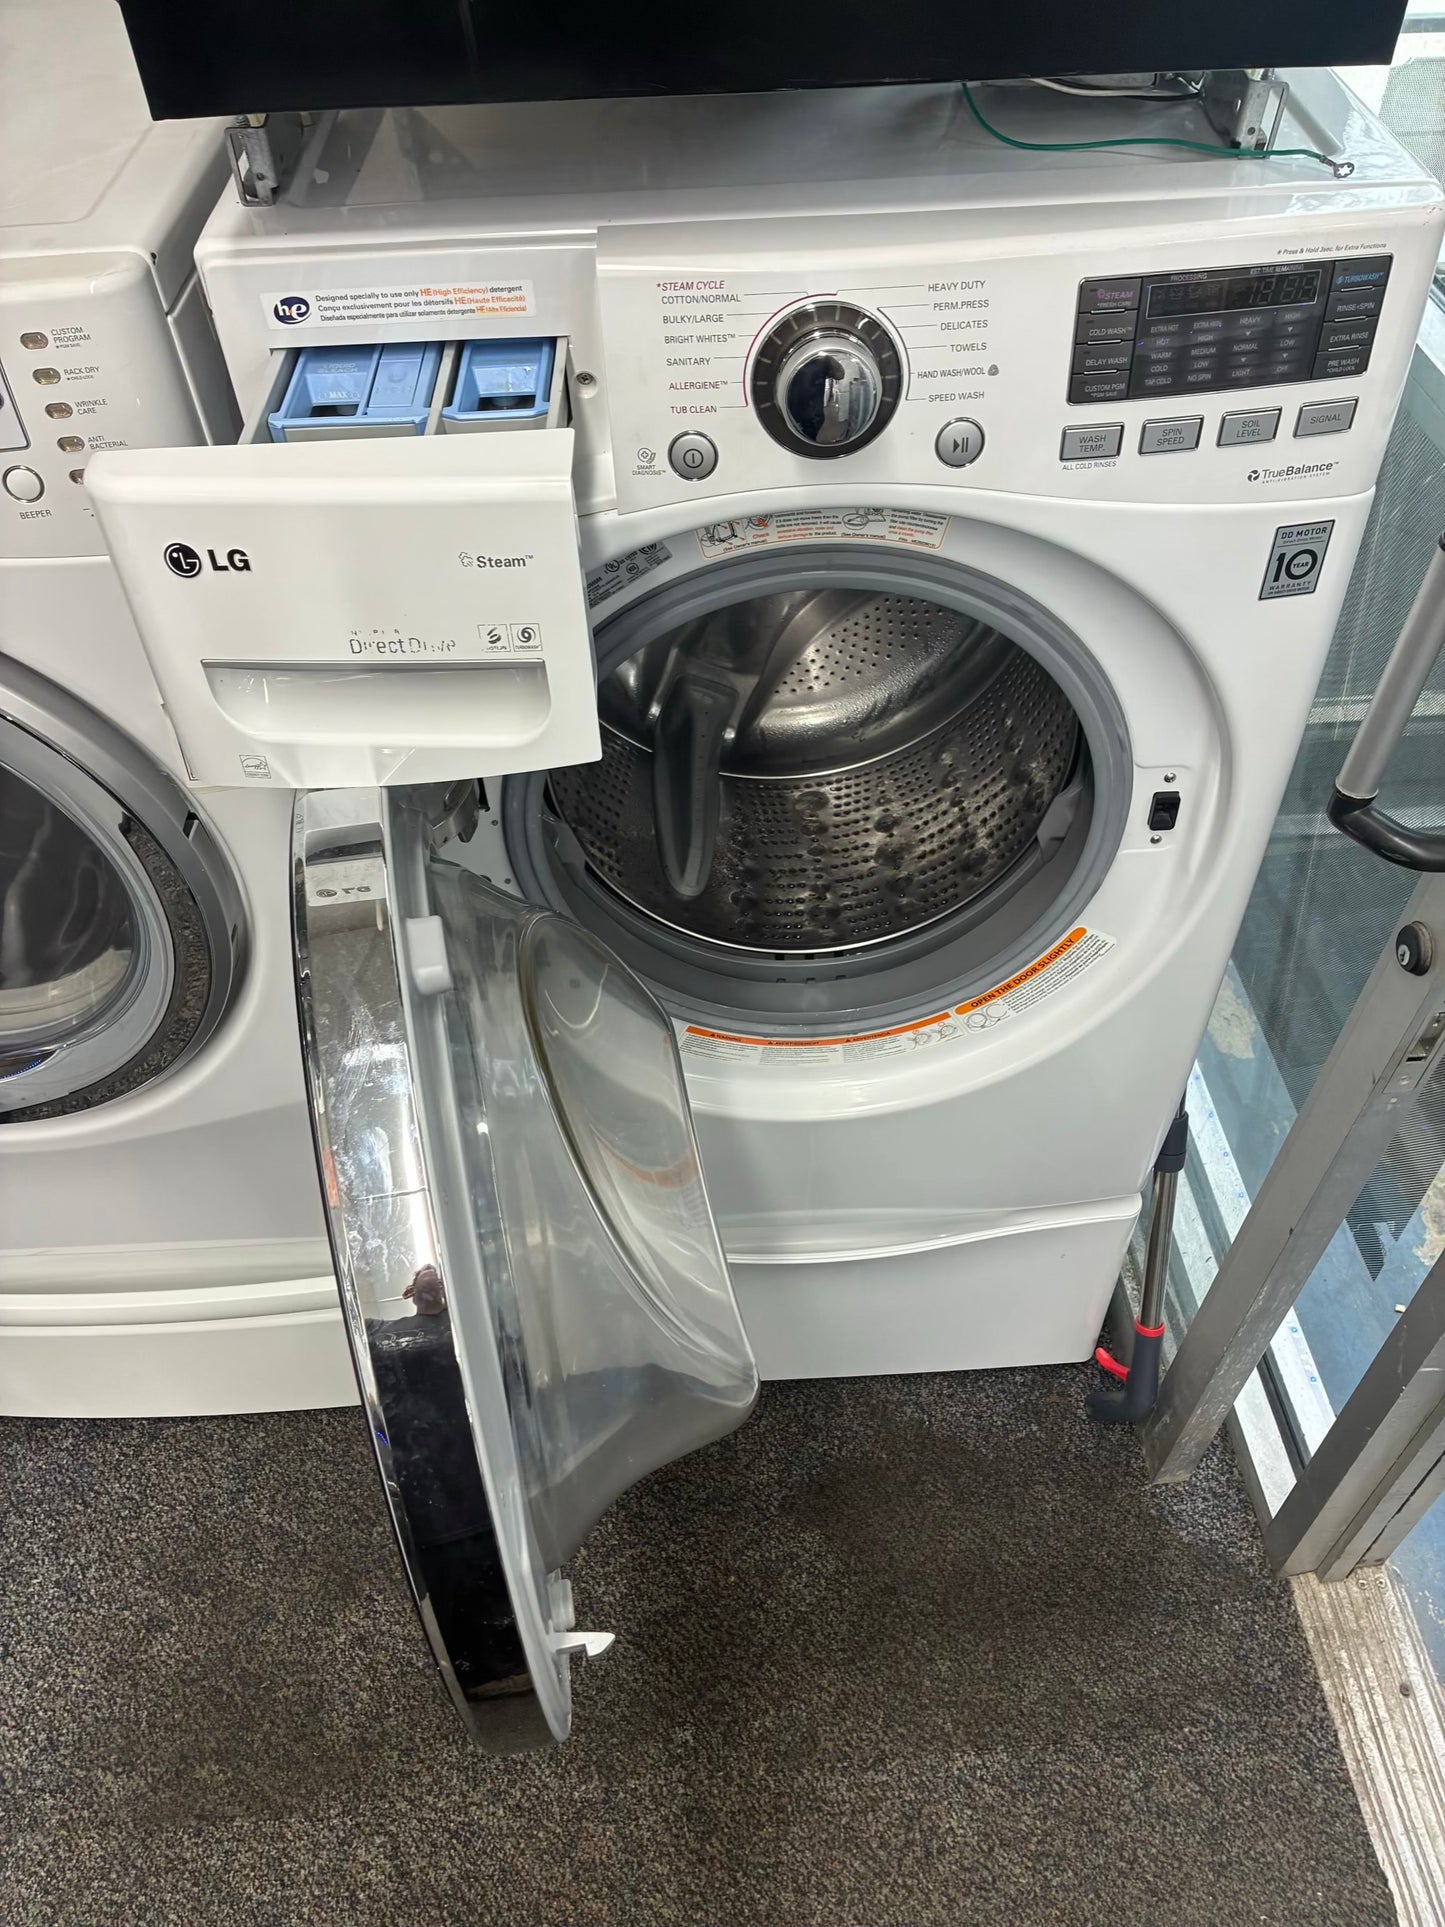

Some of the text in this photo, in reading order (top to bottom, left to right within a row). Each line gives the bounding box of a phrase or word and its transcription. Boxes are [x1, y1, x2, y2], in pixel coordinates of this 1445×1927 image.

[1170, 273, 1208, 281] PROCESSING
[696, 280, 725, 290] CYCLE
[928, 280, 986, 292] HEAVY DUTY
[315, 294, 348, 303] Designed
[349, 292, 380, 301] specially
[403, 290, 419, 298] only
[489, 285, 523, 293] detergent
[661, 294, 741, 304] COTTON/NORMAL
[1105, 290, 1134, 299] STEAM
[318, 304, 341, 312] Conçu
[342, 302, 392, 311] exclusivement
[933, 299, 990, 311] PERM.PRESS
[1336, 302, 1376, 313] RINSE+SPIN
[662, 314, 724, 324] BULKY/LARGE
[1239, 316, 1262, 324] HEAVY
[940, 319, 988, 331] DELICATES
[51, 326, 84, 336] CUSTOM
[53, 334, 91, 344] PROGRAM
[664, 335, 694, 344] BRIGHT
[1197, 334, 1214, 342] HIGH
[1329, 331, 1370, 343] EXTRA RINSE
[950, 342, 987, 352] TOWELS
[1232, 344, 1258, 352] NORMAL
[1280, 339, 1296, 347] LOW
[1191, 347, 1217, 355] MEDIUM
[666, 357, 711, 366] SANITARY
[1085, 356, 1128, 367] DELAY WASH
[1194, 360, 1209, 368] LOW
[1327, 357, 1360, 367] PRE WASH
[63, 365, 100, 376] RACK DRY
[917, 367, 986, 379] HAND WASH/WOOL
[1150, 365, 1168, 373] COLD
[1231, 369, 1251, 377] LIGHT
[1144, 377, 1172, 386] TAP COLD
[1198, 373, 1212, 381] SPIN
[1084, 382, 1125, 392] CUSTOM PGM
[329, 391, 348, 399] MAX
[928, 391, 985, 402] SPEED WASH
[74, 398, 108, 408] WRINKLE
[77, 407, 97, 415] CARE
[670, 405, 717, 414] TUB CLEAN
[1309, 413, 1342, 424] SIGNAL
[1241, 419, 1261, 429] SOIL
[1162, 428, 1183, 437] SPIN
[1236, 428, 1261, 438] LEVEL
[87, 435, 105, 443] ANTI
[1079, 435, 1107, 444] WASH
[1156, 436, 1185, 446] SPEED
[89, 440, 129, 450] BACTERIAL
[1079, 444, 1105, 453] TEMP.
[1075, 462, 1092, 470] COLD
[1093, 460, 1117, 468] RINSES
[19, 509, 52, 520] BEEPER
[1281, 526, 1328, 540] DD MOTOR
[207, 549, 251, 571] LG
[476, 554, 533, 568] Steam™
[1292, 561, 1310, 569] YEAR
[1273, 548, 1318, 583] 10
[1269, 581, 1312, 591] WARRANTY
[970, 993, 996, 1008] OPEN
[996, 983, 1014, 995] THE
[1013, 967, 1039, 985] DOOR
[1038, 938, 1074, 969] SLIGHTLY
